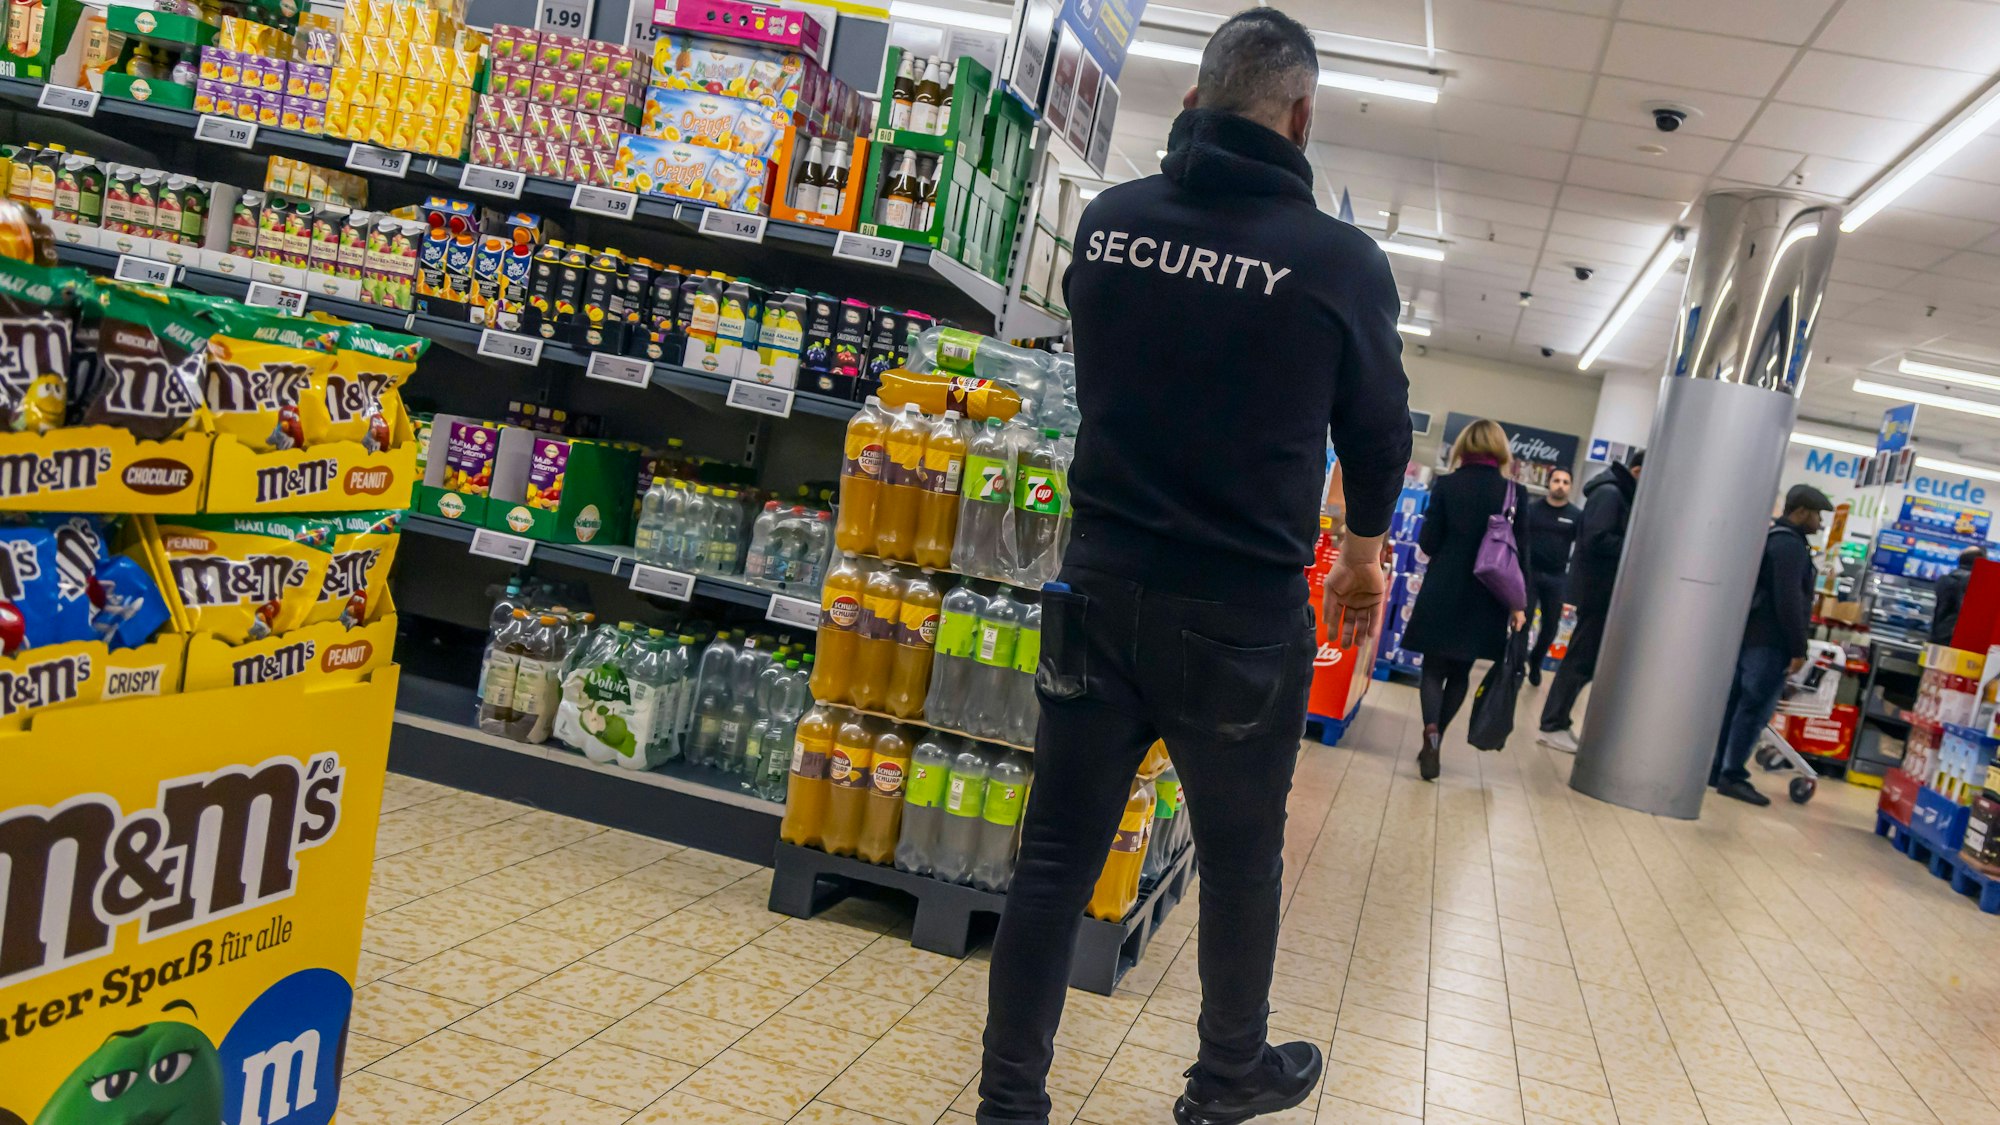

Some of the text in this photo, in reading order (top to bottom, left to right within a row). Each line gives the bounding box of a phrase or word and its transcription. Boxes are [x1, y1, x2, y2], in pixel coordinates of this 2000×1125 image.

[545, 8, 582, 28] 1.99
[635, 23, 656, 40] 1.9
[71, 98, 90, 109] 1.99
[681, 111, 731, 138] Orange
[229, 128, 247, 141] 1.19
[381, 158, 400, 168] 1.39
[654, 157, 706, 186] Orange
[495, 179, 514, 190] 1.99
[607, 200, 627, 211] 1.39
[736, 223, 756, 234] 1.49
[872, 247, 892, 258] 1.39
[1086, 230, 1292, 296] SECURITY
[147, 270, 166, 281] 1.48
[277, 297, 298, 308] 2.68
[720, 322, 742, 331] ANANAS
[254, 327, 304, 348] MAXI 400g
[352, 336, 372, 351] MAXI
[776, 334, 799, 342] ANANAS
[513, 345, 532, 357] 1.93
[1510, 433, 1560, 462] hriften
[126, 466, 188, 488] CHOCOLATE
[350, 469, 387, 490] PEANUT
[1026, 476, 1052, 510] 7up
[234, 518, 294, 541] MAXI 400g
[166, 535, 210, 552] PEANUT
[327, 644, 366, 667] PEANUT
[108, 669, 160, 696] CRISPY
[588, 671, 629, 696] Volvic
[98, 938, 214, 1008] Spaß
[218, 934, 254, 966] für
[256, 914, 293, 952] alle
